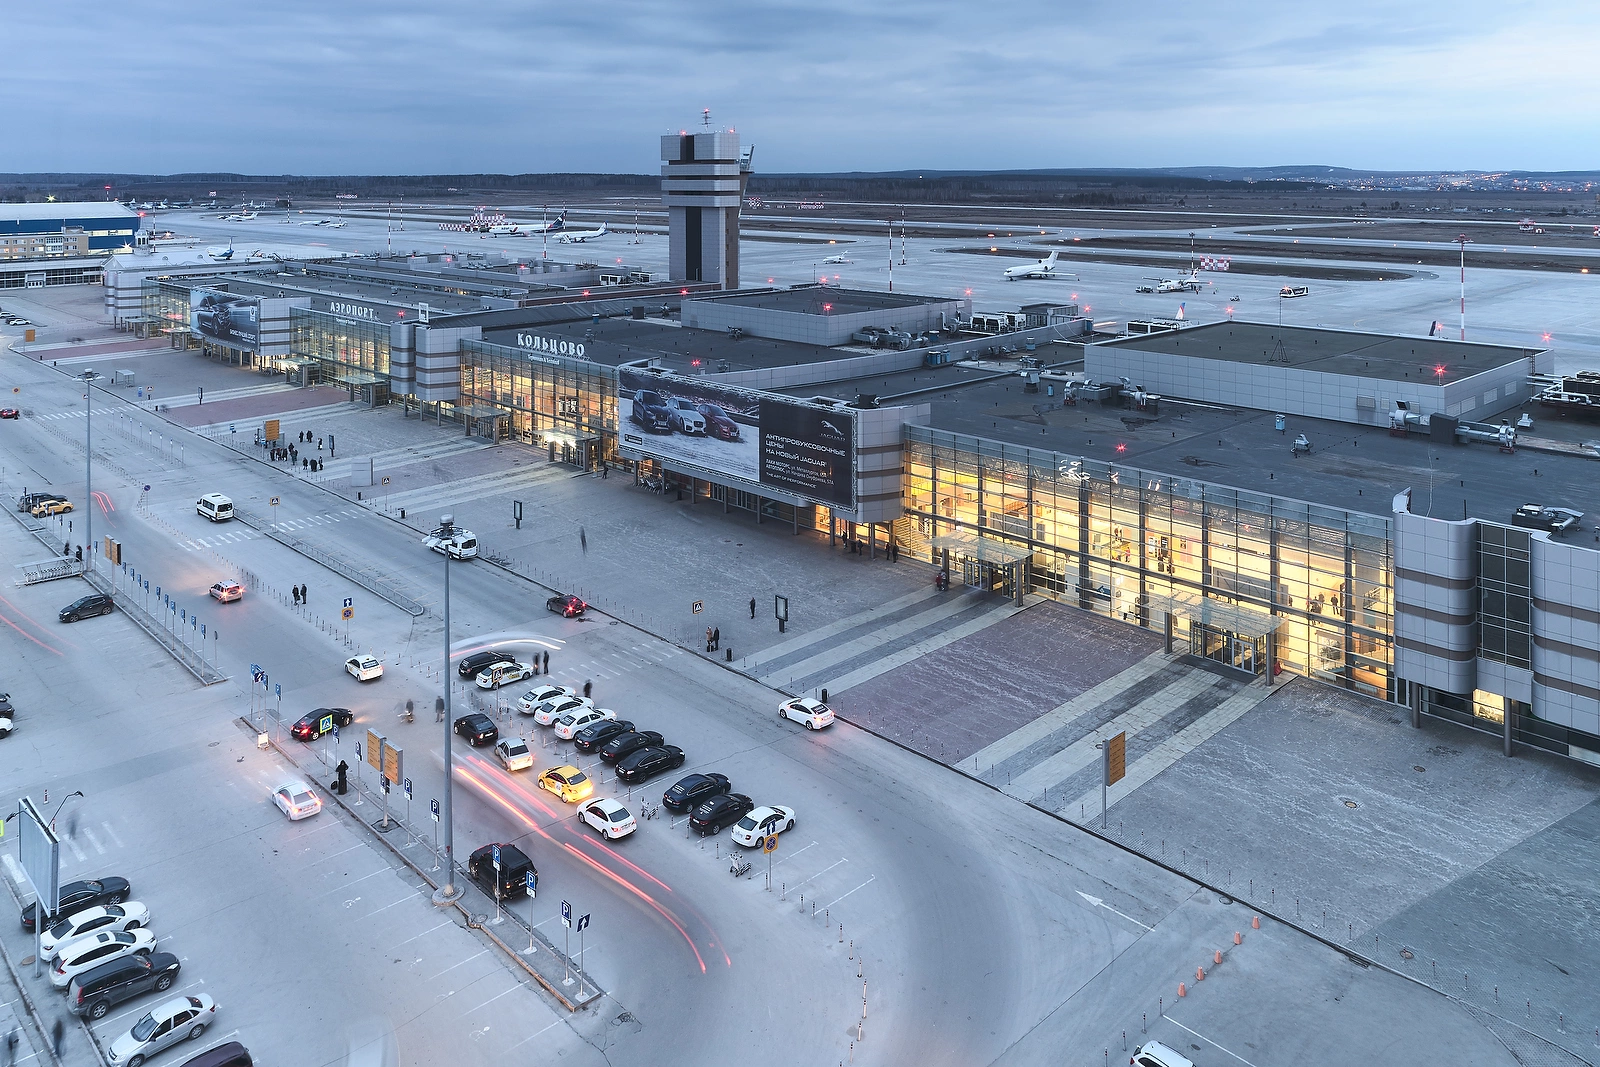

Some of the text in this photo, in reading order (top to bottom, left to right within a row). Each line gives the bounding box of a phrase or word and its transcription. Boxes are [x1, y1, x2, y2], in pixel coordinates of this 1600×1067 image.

[330, 302, 374, 318] АЭРОПОРТ
[517, 333, 585, 357] КОЛЬЦОВО
[766, 440, 785, 449] ЦЕНЫ
[776, 450, 799, 460] НОВЫЙ
[494, 849, 499, 859] P
[528, 873, 534, 884] P
[563, 903, 569, 914] P
